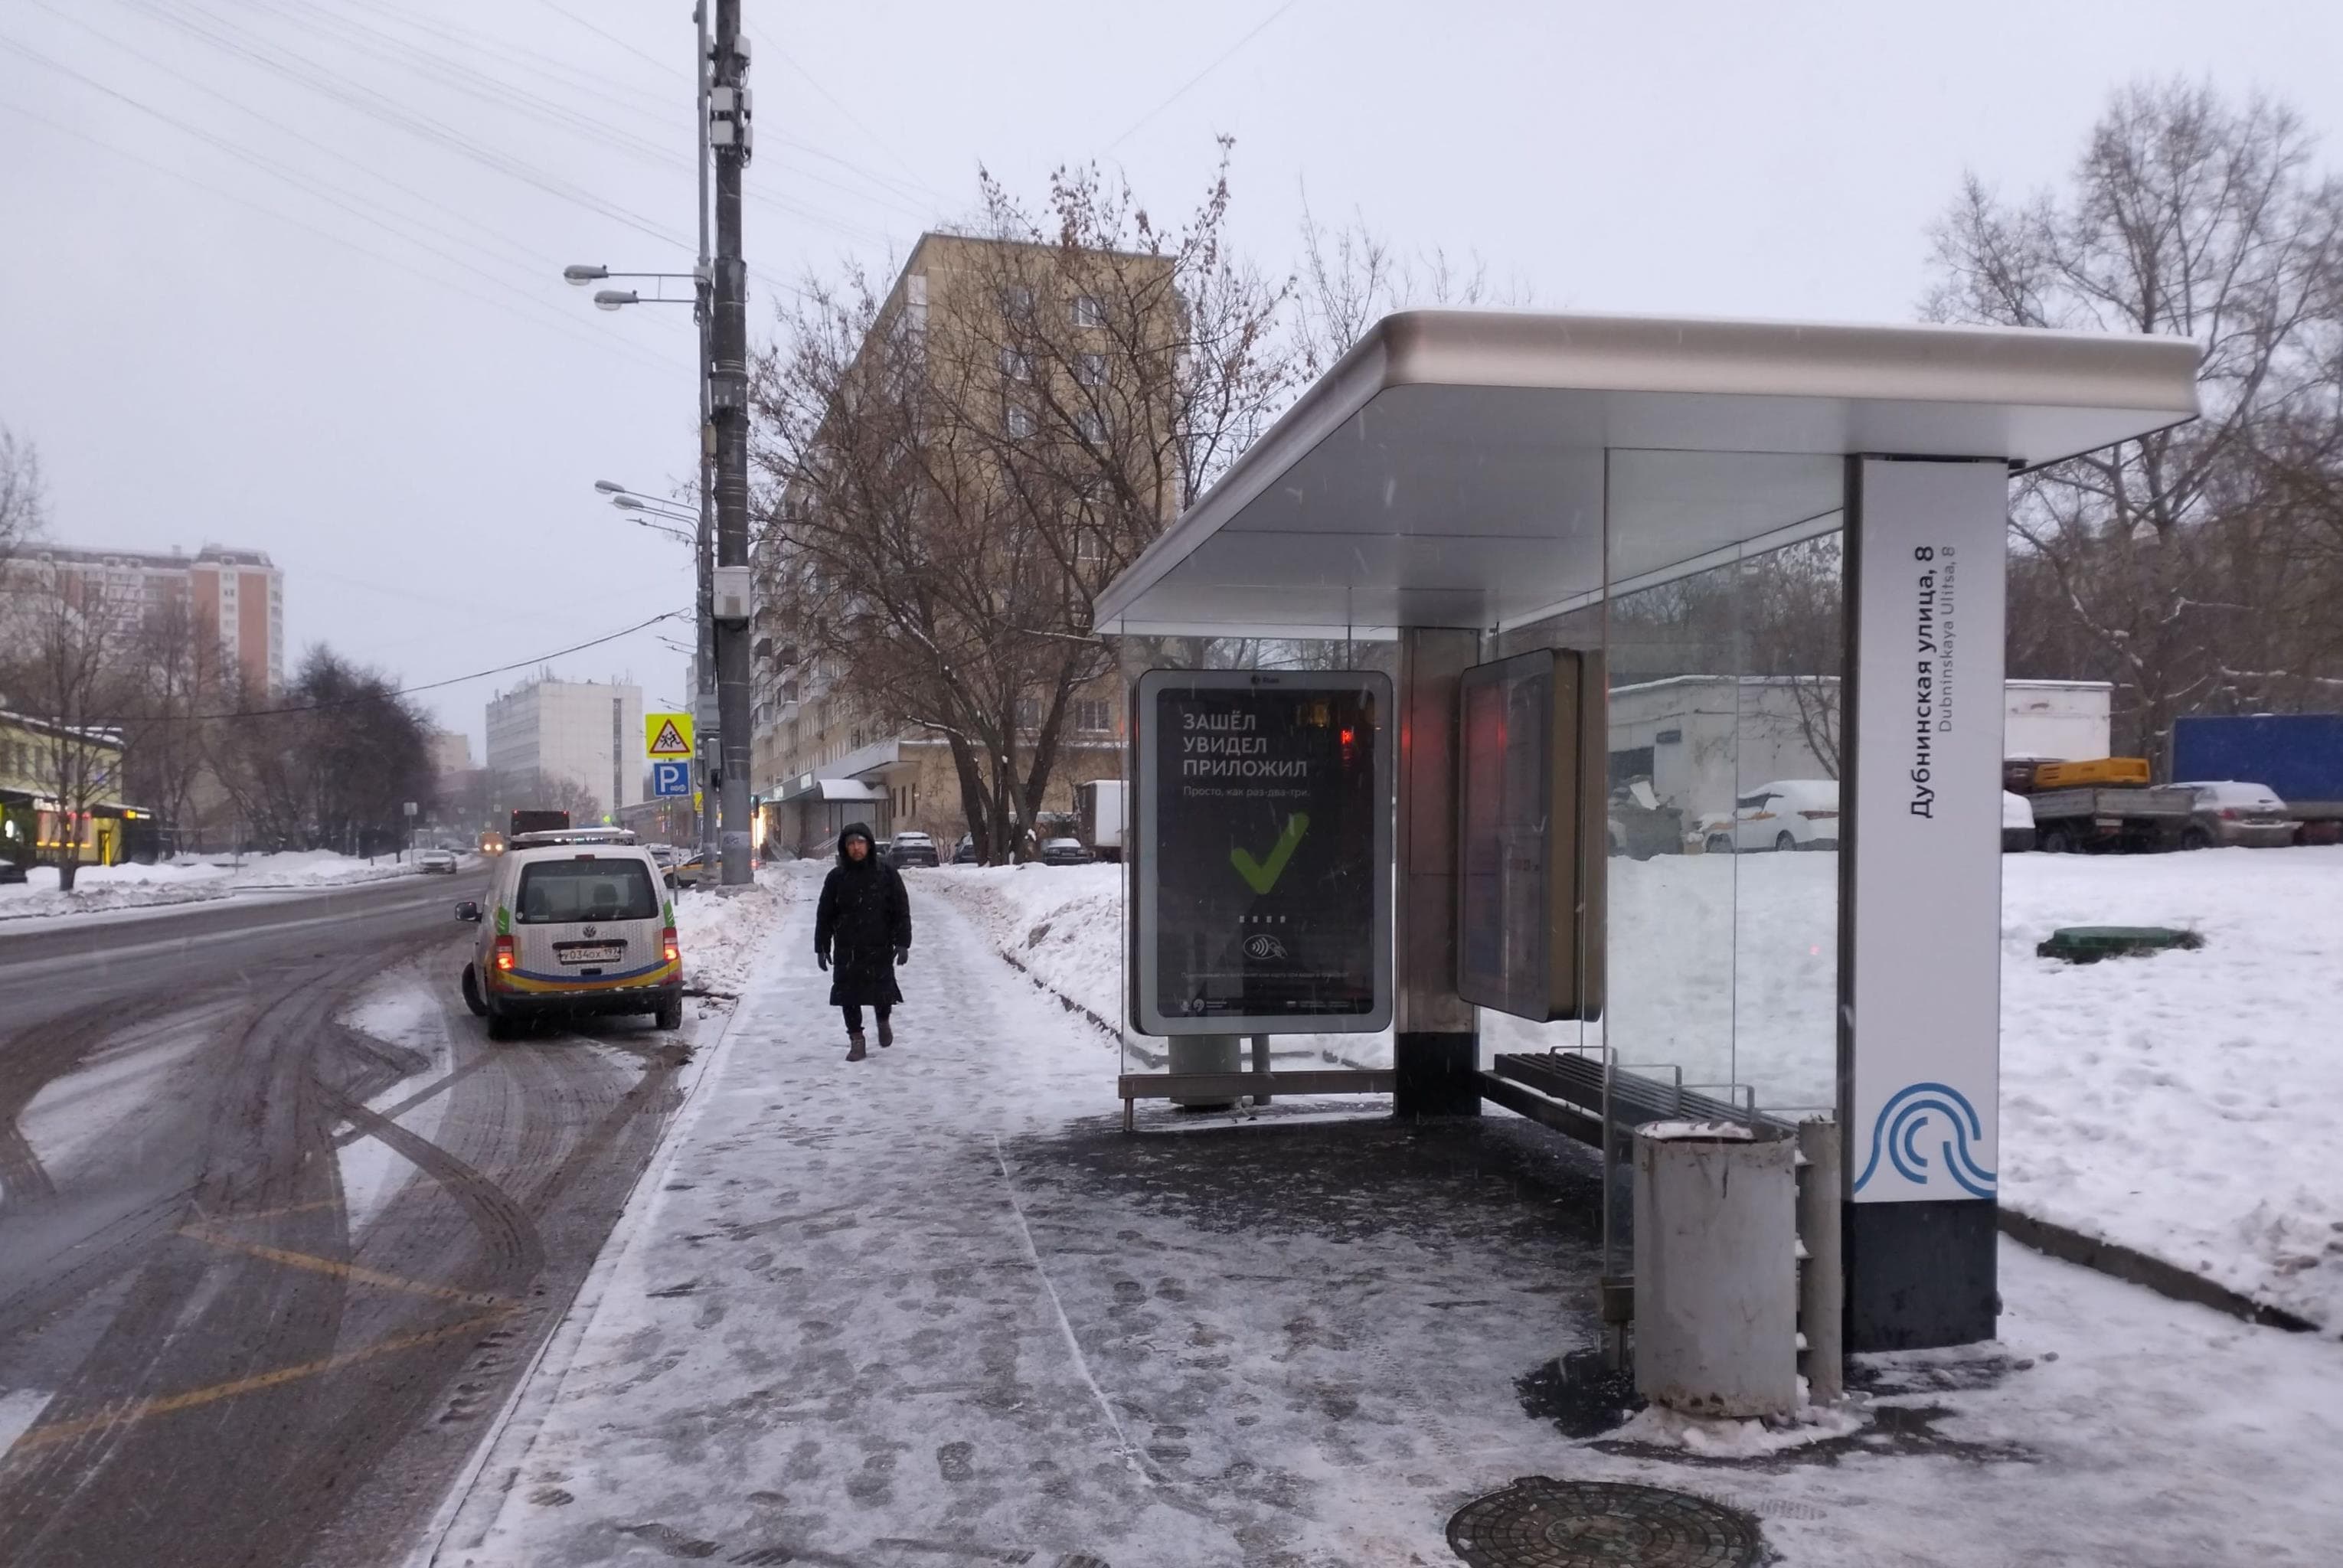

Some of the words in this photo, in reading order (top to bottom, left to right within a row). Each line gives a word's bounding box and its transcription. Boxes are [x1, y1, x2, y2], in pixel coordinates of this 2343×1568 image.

[1914, 545, 1935, 562] 8
[1941, 546, 1956, 557] 8
[1940, 560, 1957, 616] Ulitsa,
[1916, 569, 1938, 653] улица,
[1939, 620, 1957, 733] Dubninskaya
[1183, 710, 1256, 731] ЗАШЁЛ
[1183, 736, 1268, 756] УВИДЕЛ
[1910, 660, 1936, 819] Дубнинская
[659, 766, 679, 792] P
[1183, 760, 1308, 778] ПРИЛОЖИЛ
[1183, 786, 1224, 798] Просто,
[1227, 789, 1244, 797] как
